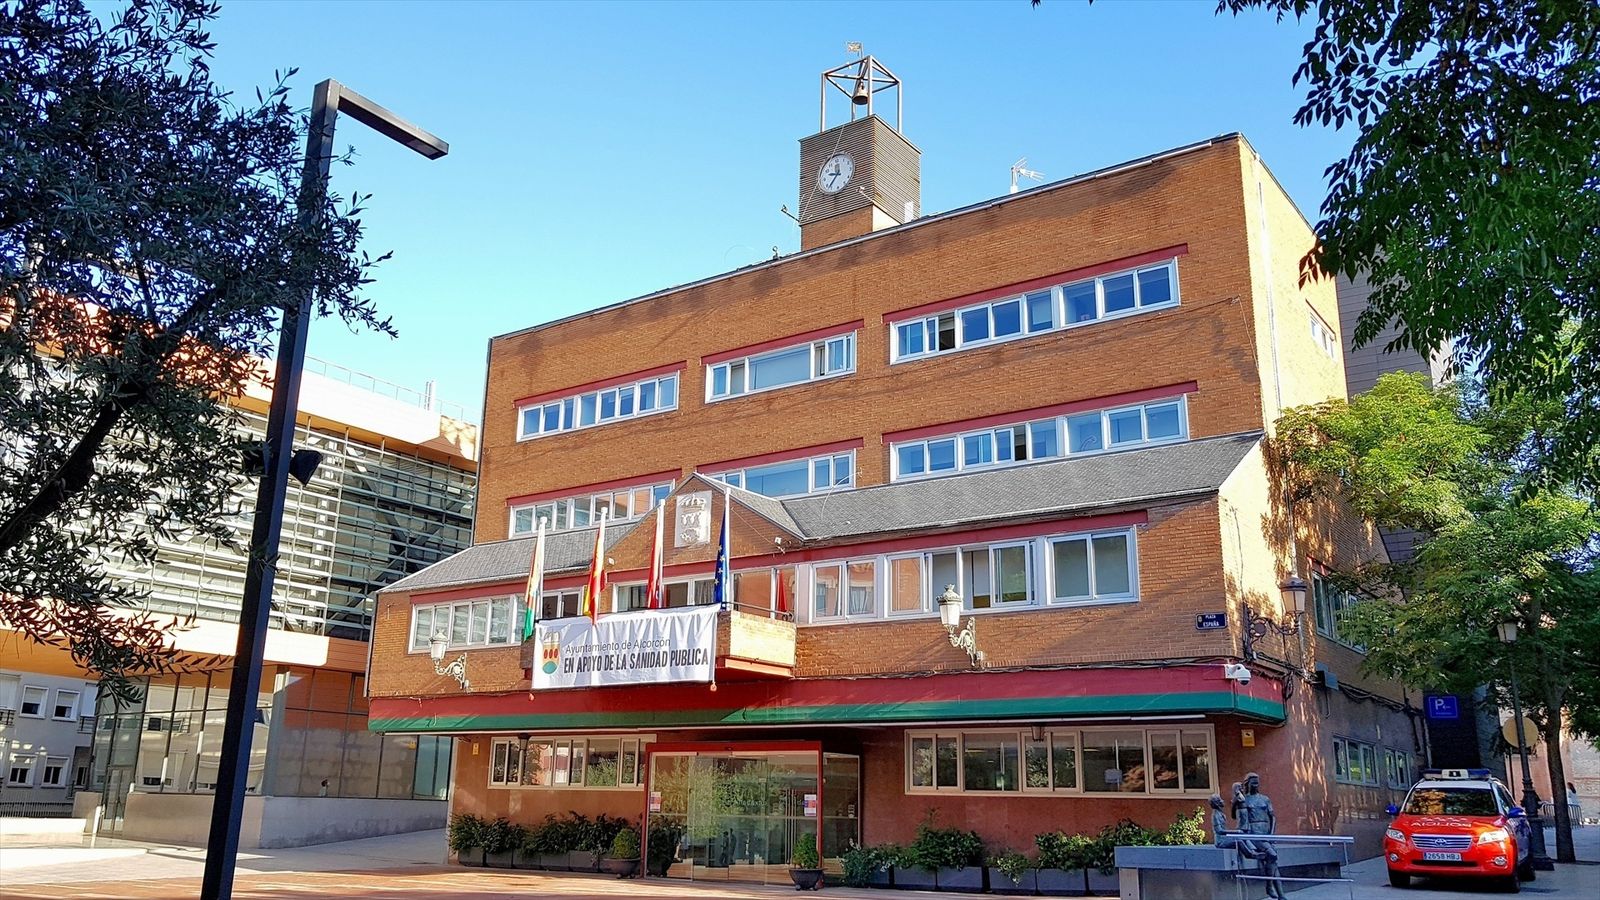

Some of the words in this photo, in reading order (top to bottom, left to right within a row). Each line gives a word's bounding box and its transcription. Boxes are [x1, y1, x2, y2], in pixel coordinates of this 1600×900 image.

[566, 641, 619, 656] Ayuntamiento
[622, 640, 632, 650] de
[634, 637, 671, 649] Alcorcón
[564, 657, 574, 674] EN
[577, 655, 602, 672] APOYO
[604, 654, 615, 670] DE
[616, 653, 627, 670] LA
[630, 651, 668, 669] SANIDAD
[670, 648, 708, 667] PUBLICA
[1435, 699, 1444, 710] P
